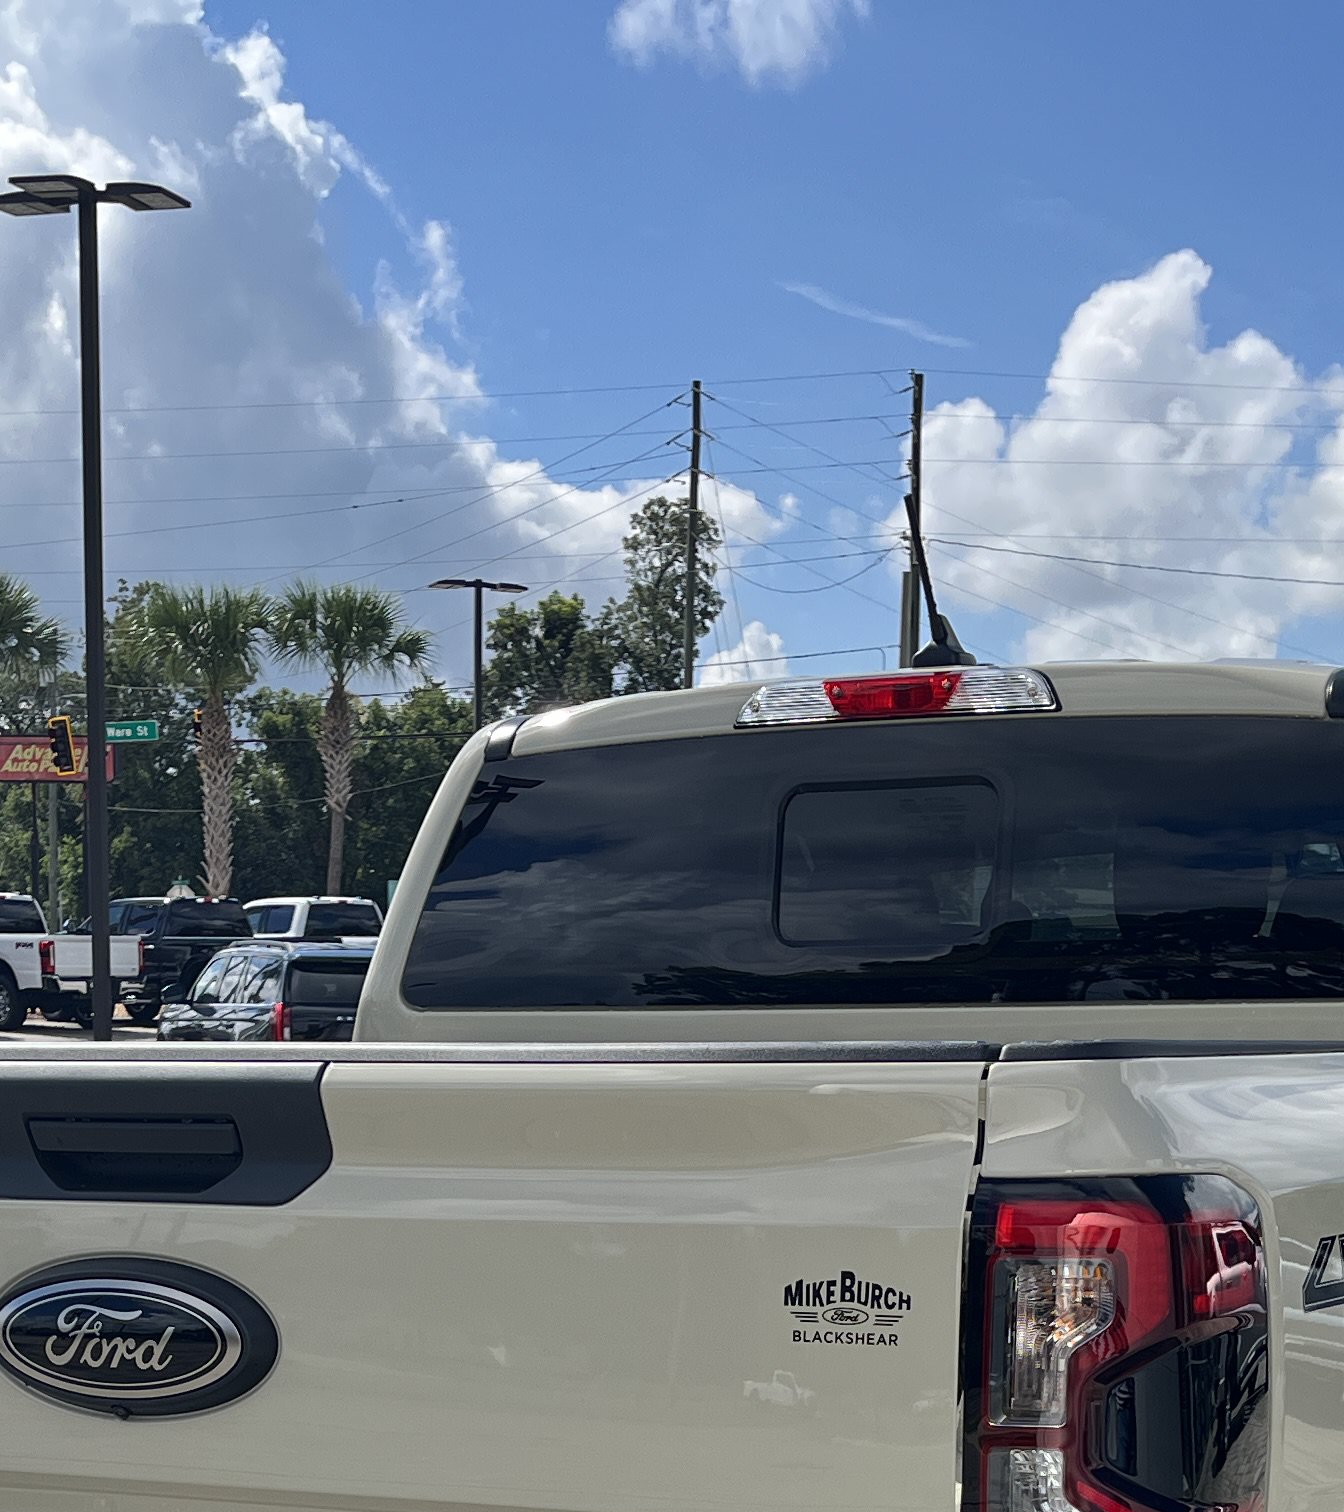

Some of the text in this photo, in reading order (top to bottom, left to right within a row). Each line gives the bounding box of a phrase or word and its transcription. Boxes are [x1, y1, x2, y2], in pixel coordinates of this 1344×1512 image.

[136, 725, 148, 736] St
[8, 744, 82, 760] Advae
[0, 760, 38, 773] Auto
[783, 1270, 912, 1311] MIKE BURCH
[830, 1309, 860, 1322] Ford
[45, 1303, 177, 1371] Ford
[792, 1329, 899, 1347] BLACKSHEAR
